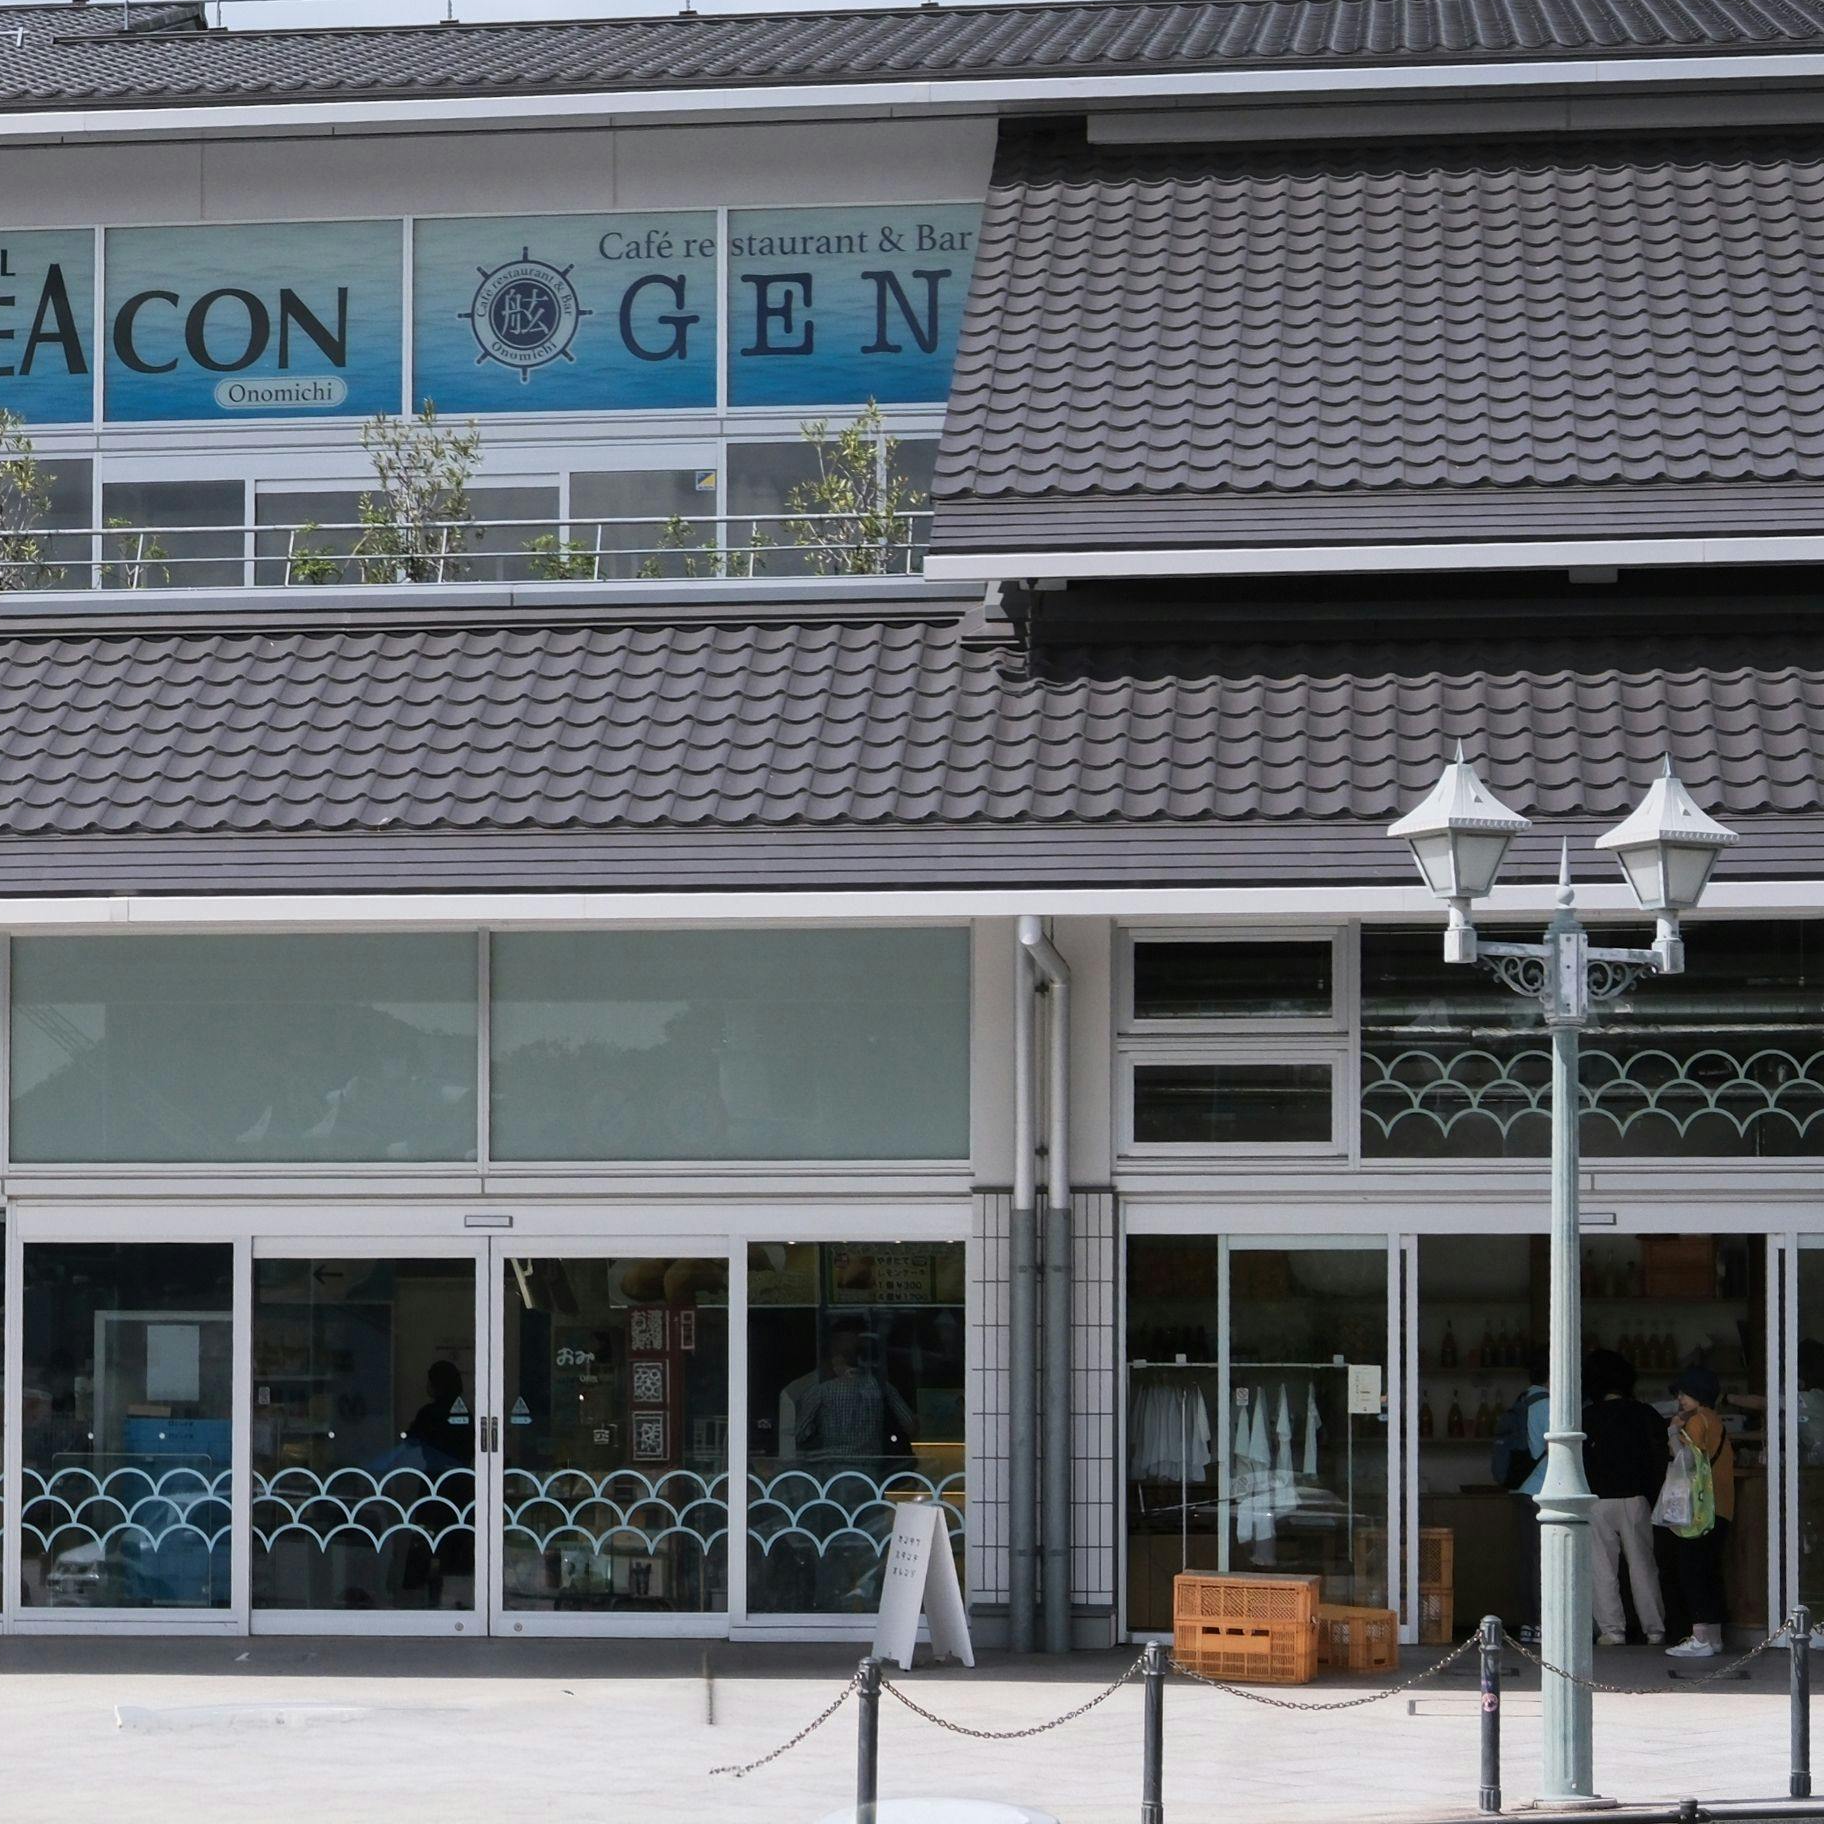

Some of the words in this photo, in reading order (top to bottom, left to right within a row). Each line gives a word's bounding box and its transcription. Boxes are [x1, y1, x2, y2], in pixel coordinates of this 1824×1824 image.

[598, 229, 673, 260] Café
[684, 230, 868, 258] restaurant
[878, 225, 905, 253] &
[915, 223, 973, 252] Bar
[619, 268, 952, 362] GEN
[228, 380, 333, 404] Onomichi
